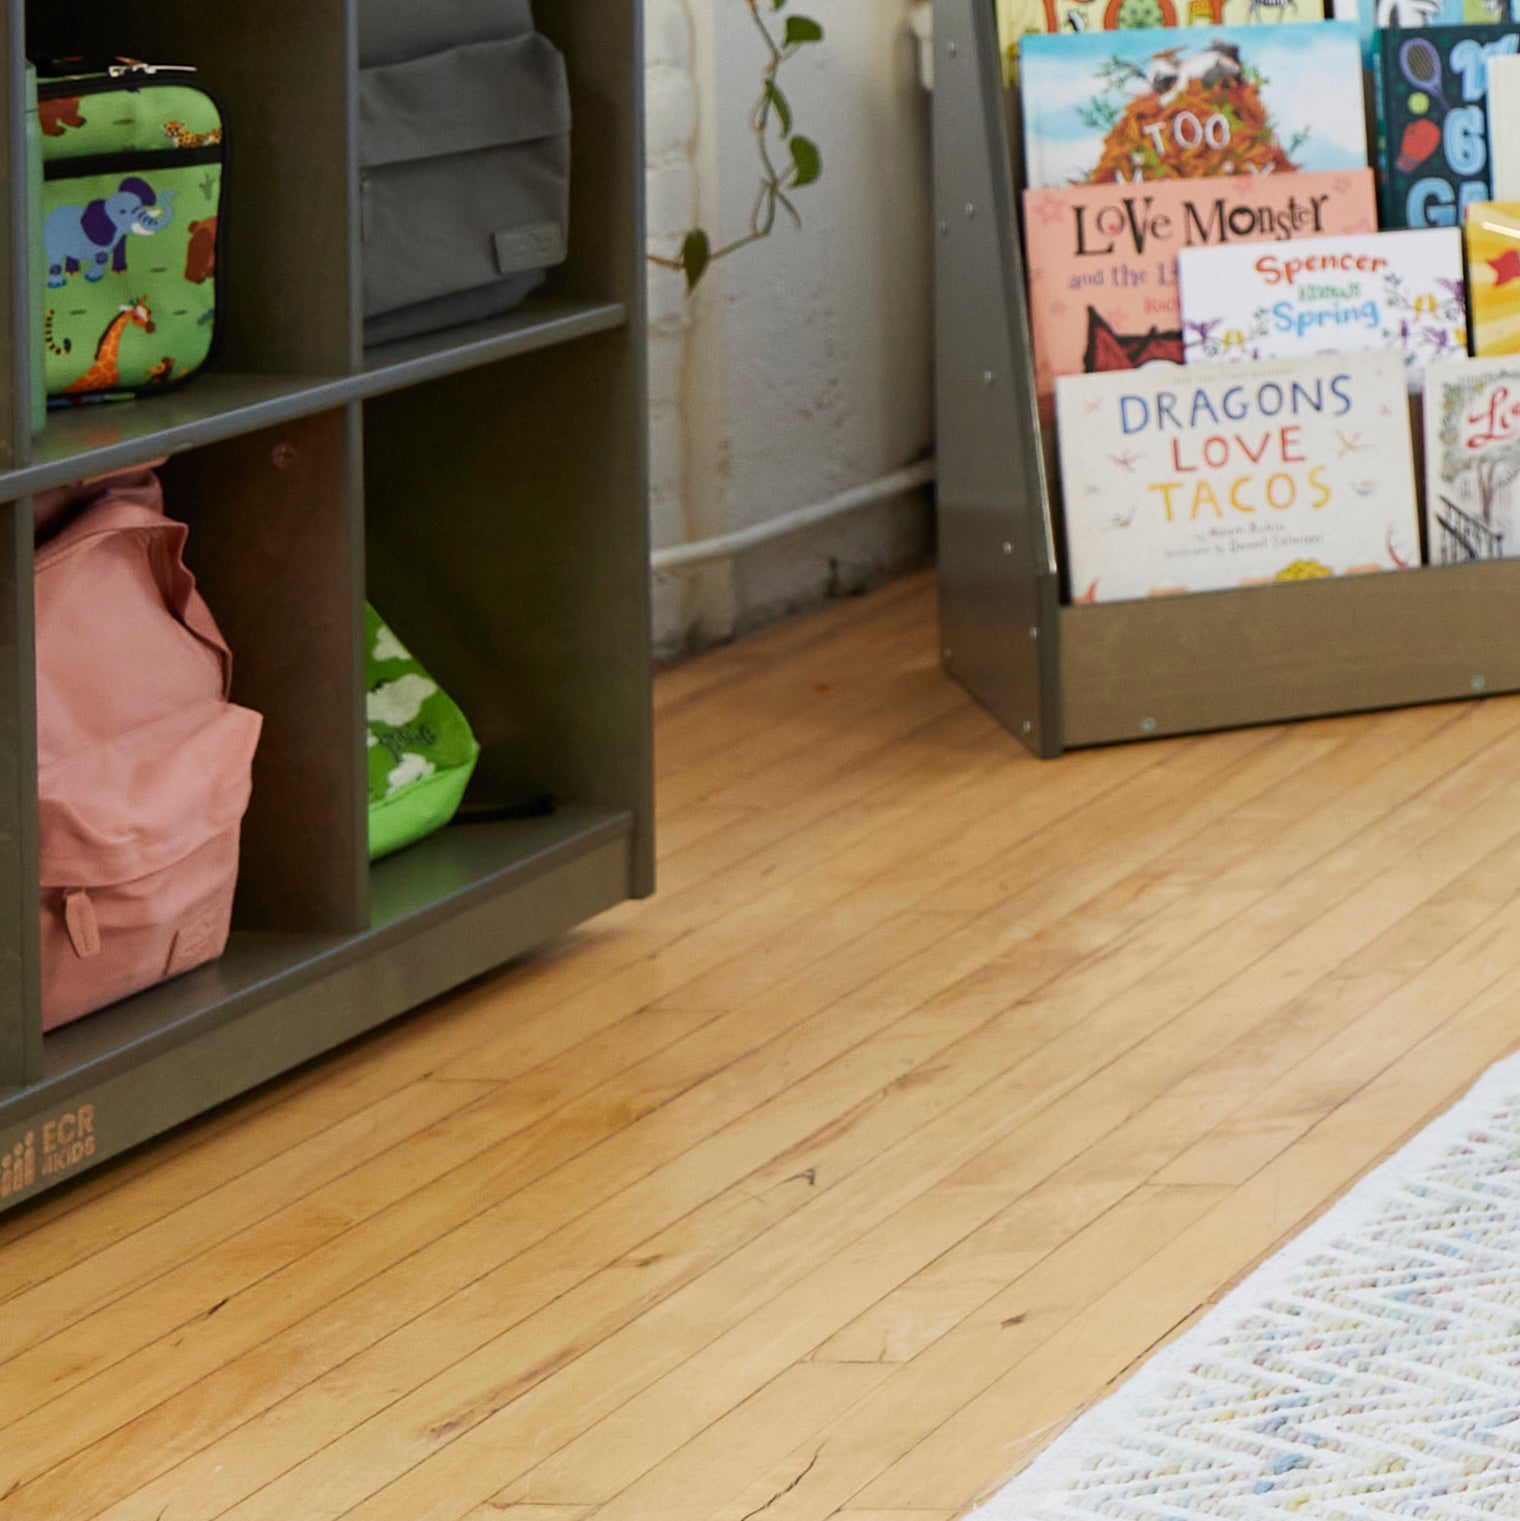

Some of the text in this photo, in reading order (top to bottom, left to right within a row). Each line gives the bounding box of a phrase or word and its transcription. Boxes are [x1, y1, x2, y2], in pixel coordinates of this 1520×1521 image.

[1143, 110, 1231, 157] TOO
[1182, 194, 1329, 246] Monster
[1069, 270, 1105, 289] and
[1111, 263, 1147, 288] the
[1255, 253, 1388, 286] Spencer
[1272, 300, 1380, 338] Spring
[1119, 374, 1353, 436] DRAGONS
[1171, 425, 1307, 473] LOVE
[1147, 464, 1334, 524] TACOS
[42, 1104, 95, 1154] ECR
